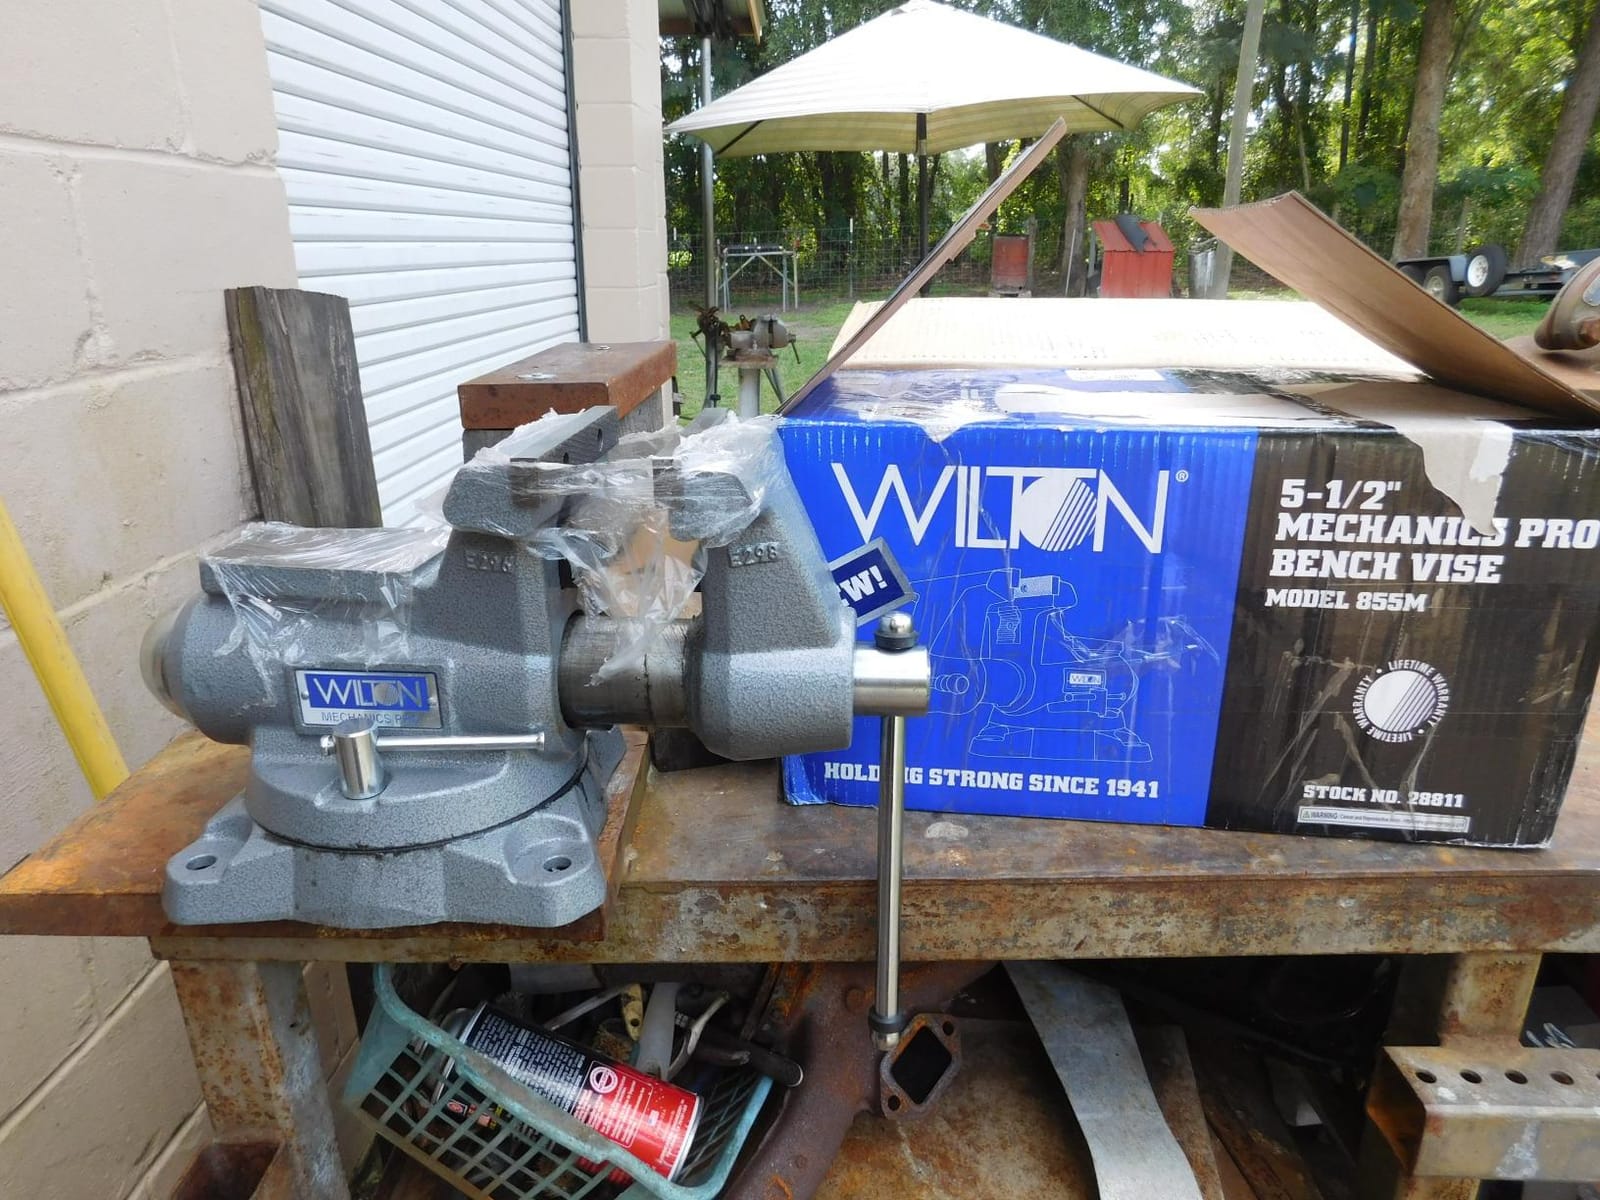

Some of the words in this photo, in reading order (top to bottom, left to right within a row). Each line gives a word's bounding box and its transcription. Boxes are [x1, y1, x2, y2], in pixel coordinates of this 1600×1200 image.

[831, 462, 1170, 554] WILTON
[1280, 478, 1402, 511] 5-1/2"
[1514, 518, 1600, 549] PRO
[1269, 548, 1401, 581] BENCH
[1411, 553, 1506, 584] VISE
[840, 564, 888, 607] W!
[1264, 588, 1349, 610] MODEL
[1356, 591, 1428, 613] 855M
[313, 677, 423, 708] WILTON
[1352, 674, 1374, 729] WARRANTY
[1388, 659, 1436, 677] LIFETIME
[1426, 672, 1450, 728] WARRANTY
[1366, 725, 1413, 743] LIFETIME
[824, 762, 924, 785] HOLDG
[929, 768, 1024, 791] STRONG
[1029, 773, 1099, 796] SINCE
[1106, 778, 1159, 799] 1941
[1303, 784, 1367, 802] STOCK
[1371, 788, 1401, 804] NO.
[1407, 791, 1465, 808] 28811
